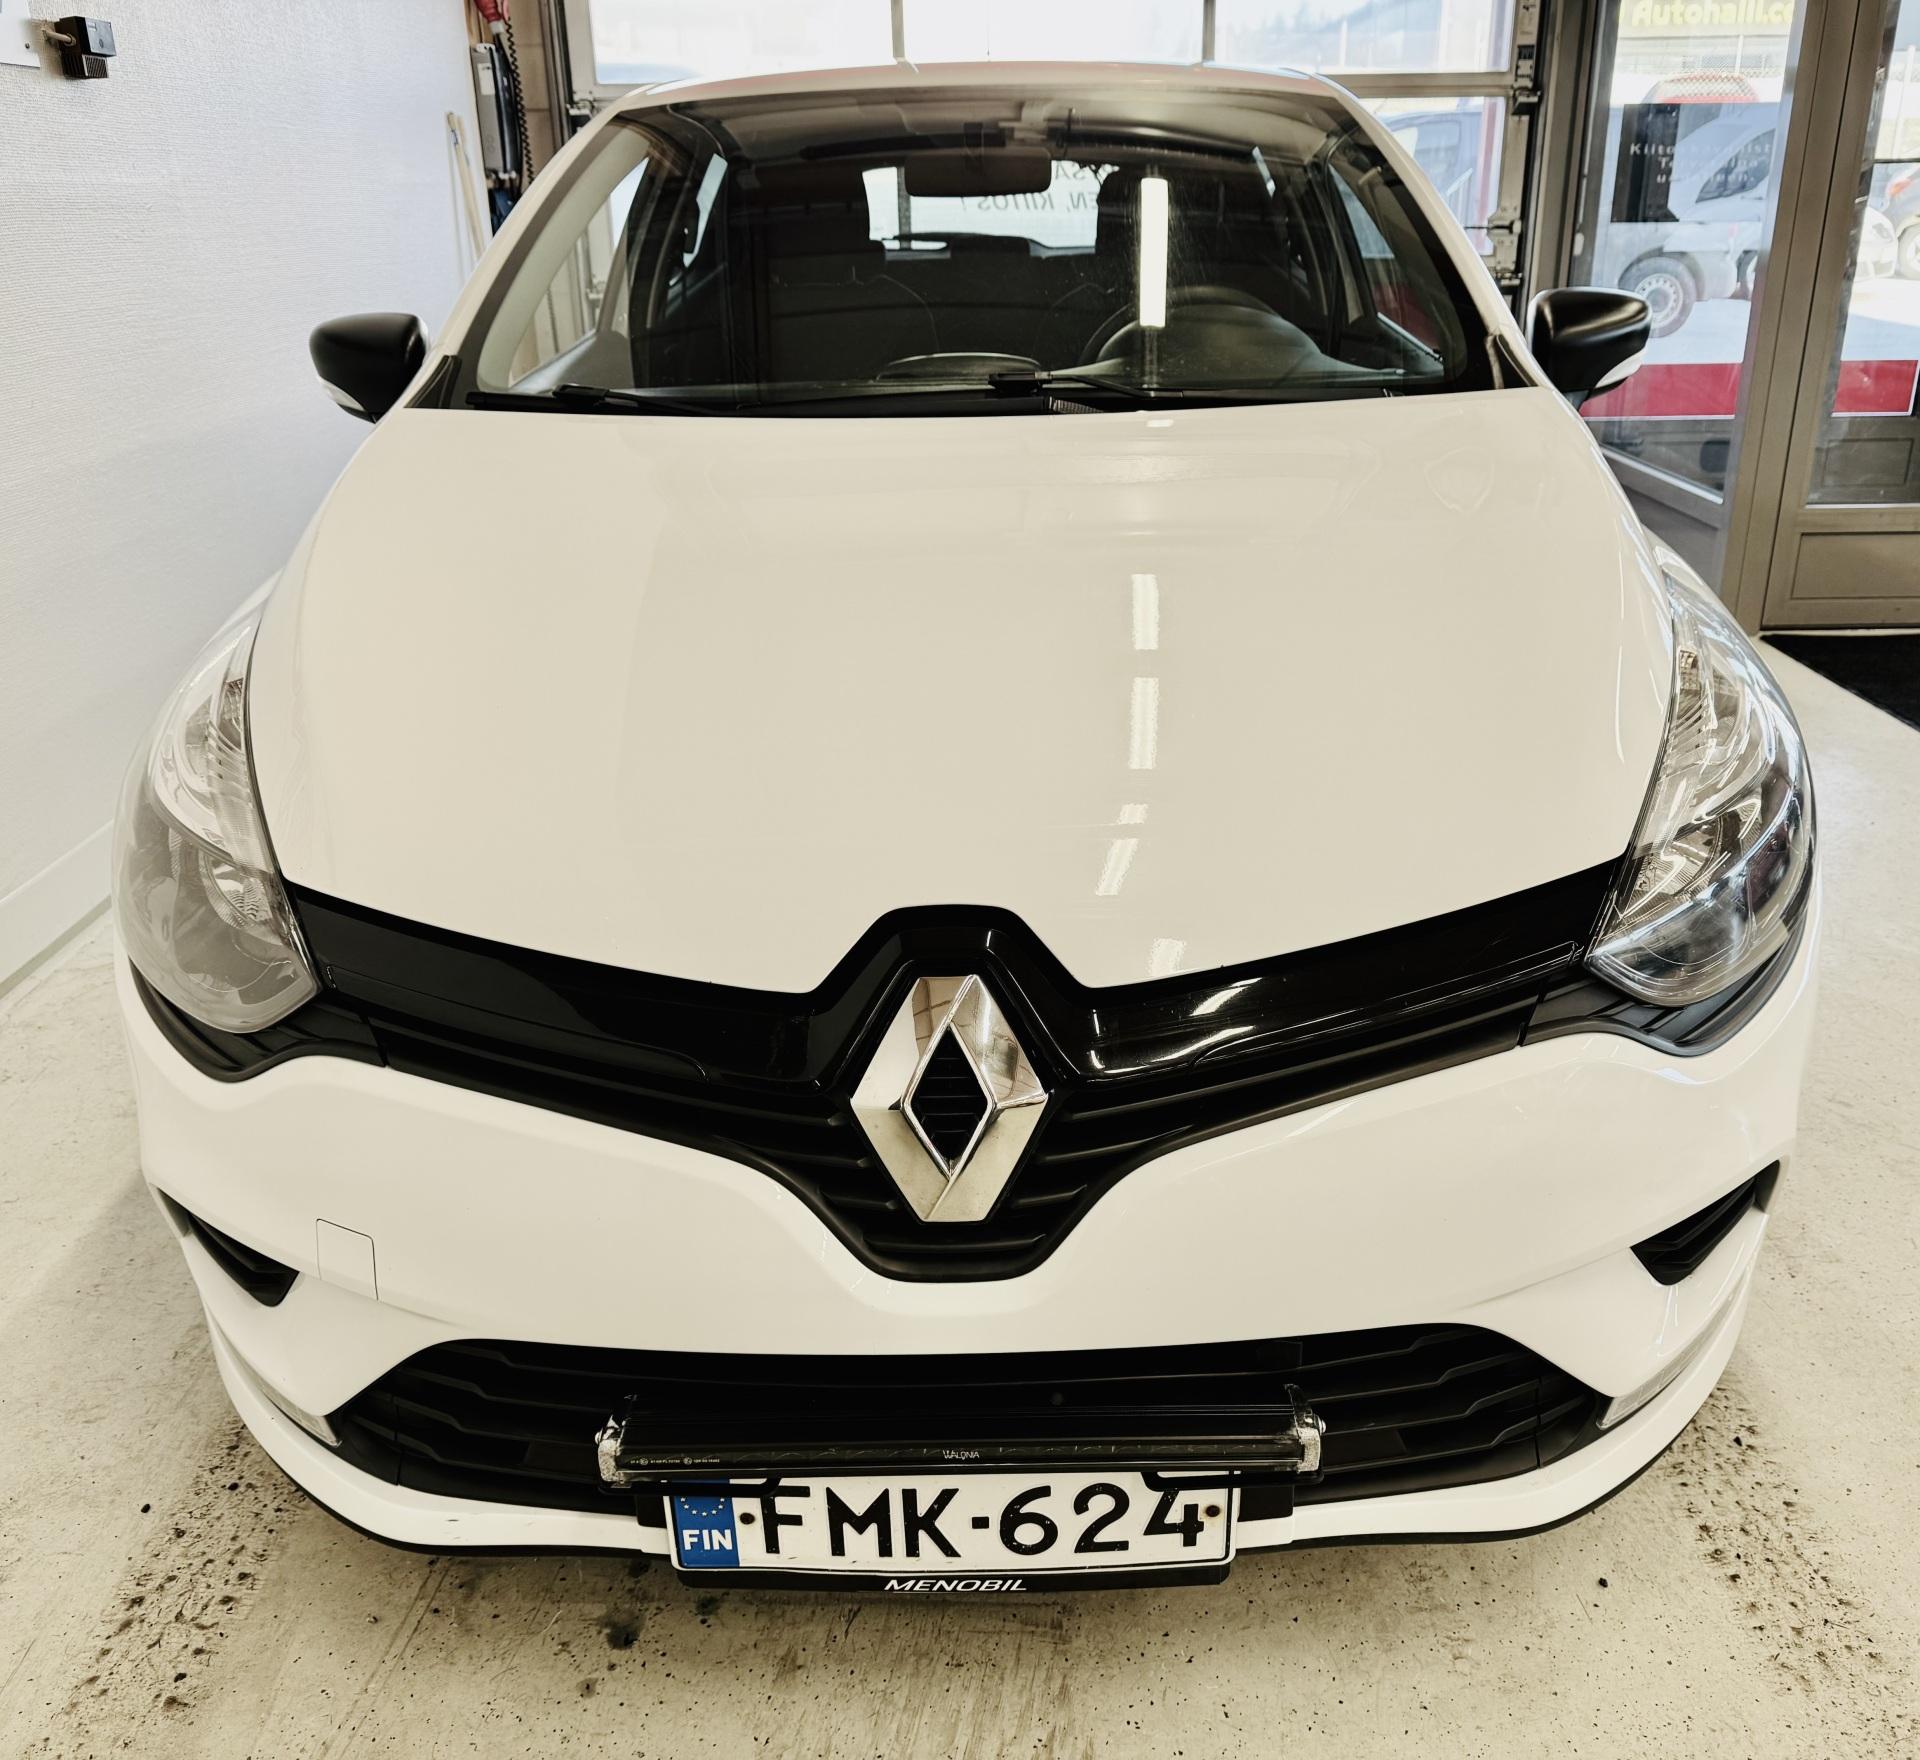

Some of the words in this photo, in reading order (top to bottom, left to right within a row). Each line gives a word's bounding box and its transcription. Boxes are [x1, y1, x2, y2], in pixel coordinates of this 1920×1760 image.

[760, 1483, 1204, 1557] FMK-624
[682, 1529, 733, 1550] FIN
[883, 1578, 1028, 1592] MENOBIL
